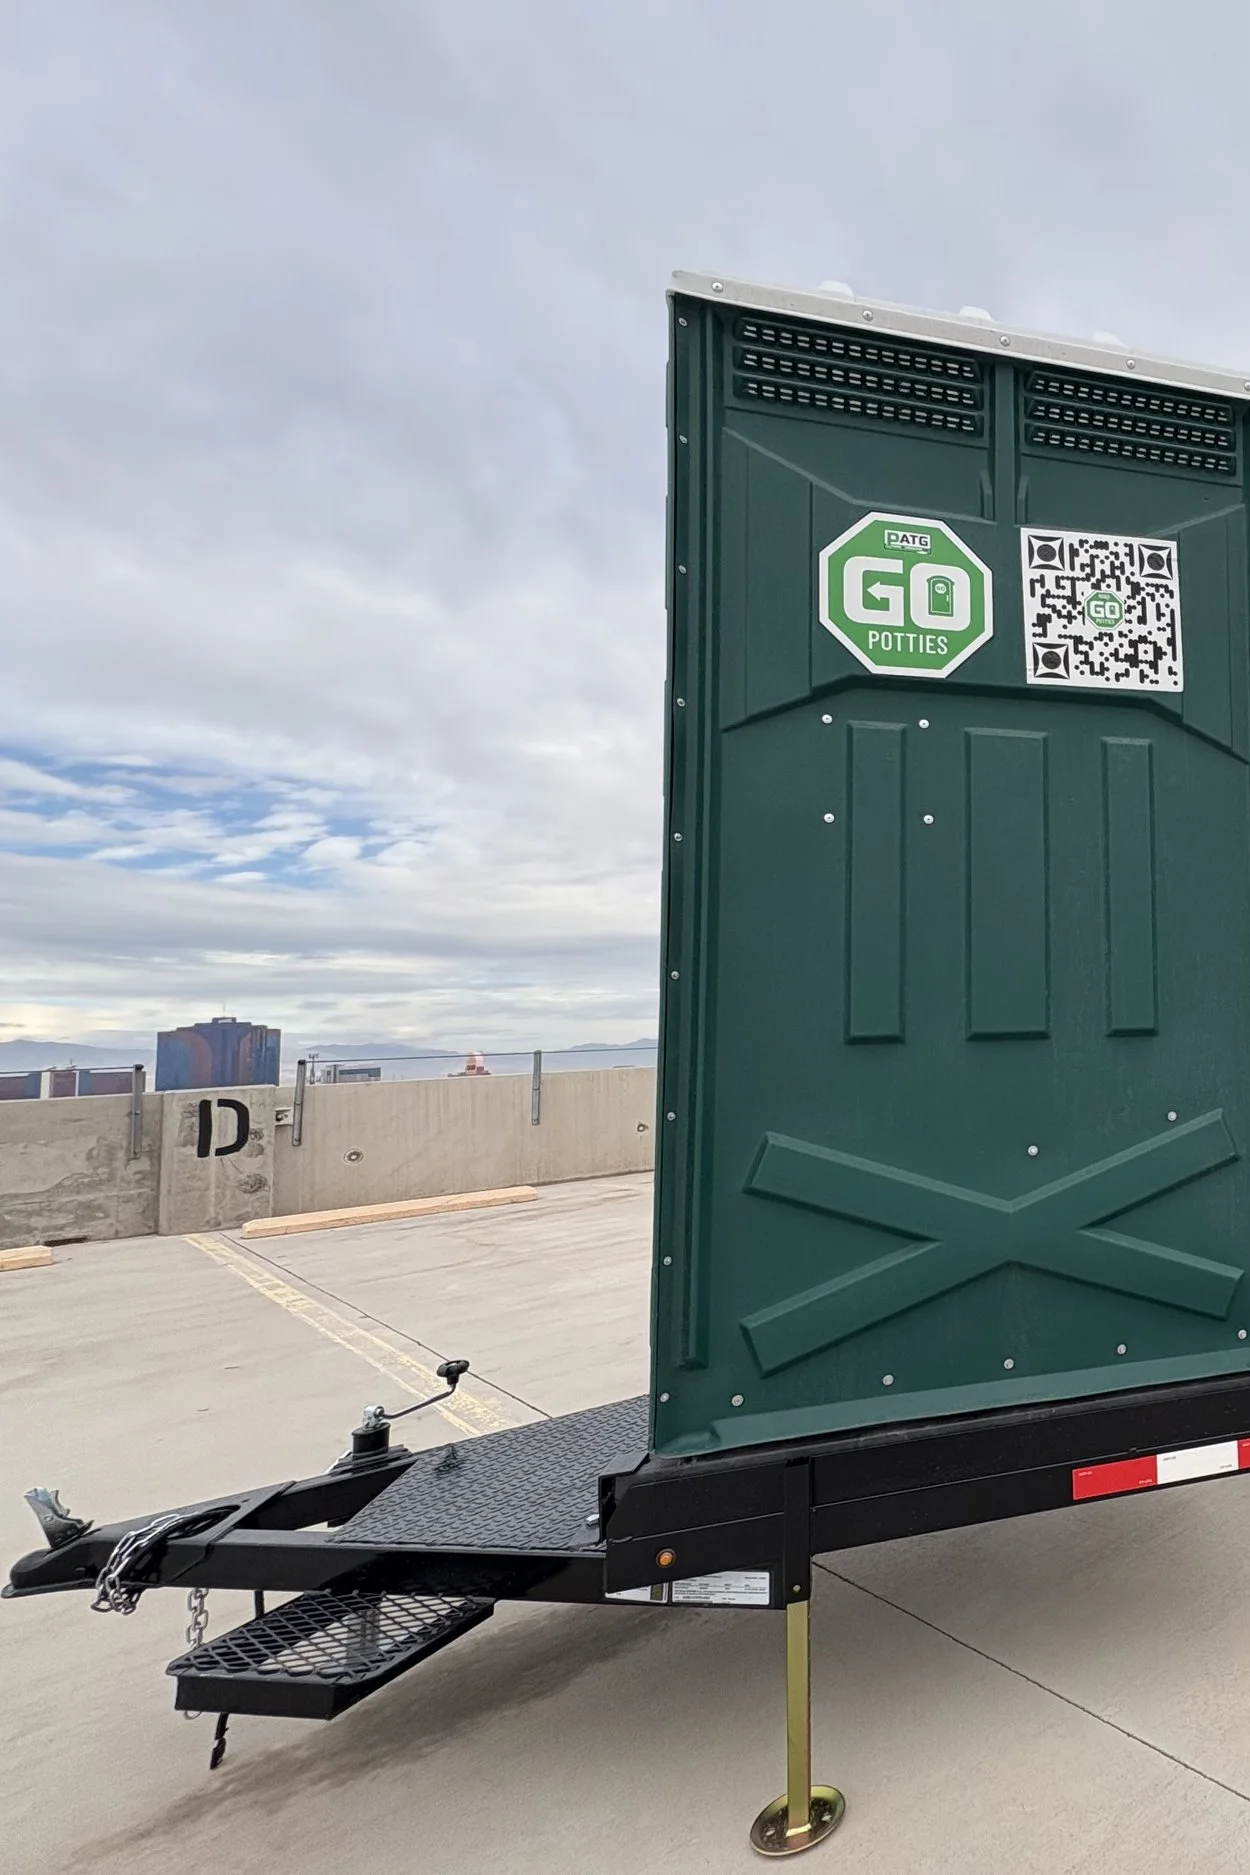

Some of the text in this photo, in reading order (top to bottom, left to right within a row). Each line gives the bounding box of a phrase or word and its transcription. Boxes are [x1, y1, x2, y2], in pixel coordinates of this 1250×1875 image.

[887, 531, 929, 547] PATG
[843, 555, 972, 632] GO
[1089, 600, 1121, 619] GO
[868, 630, 949, 656] POTTIES
[197, 1098, 250, 1158] D
